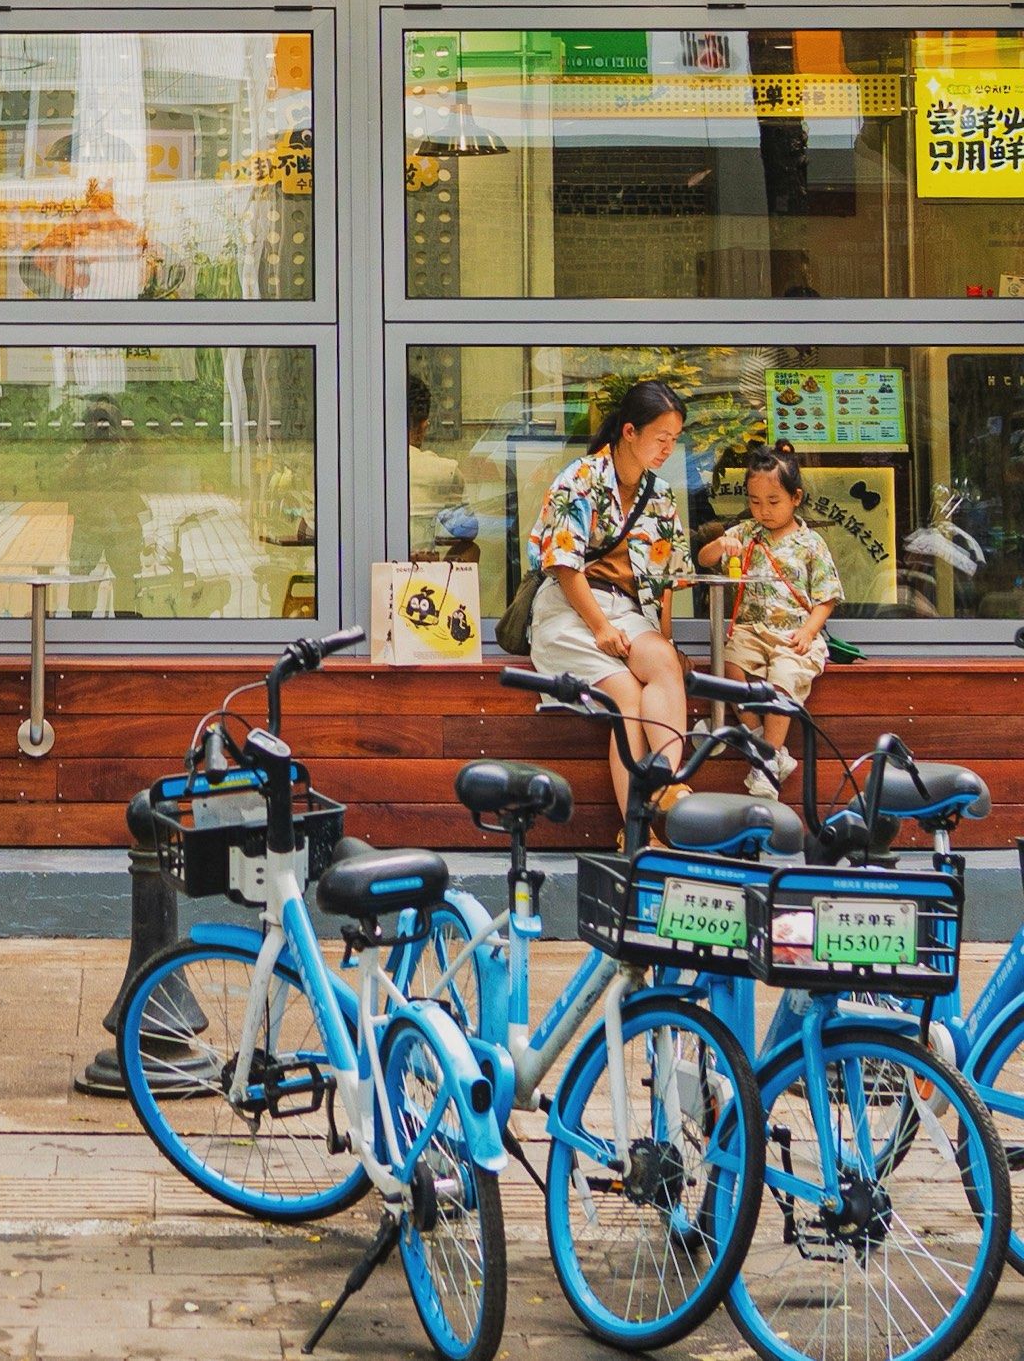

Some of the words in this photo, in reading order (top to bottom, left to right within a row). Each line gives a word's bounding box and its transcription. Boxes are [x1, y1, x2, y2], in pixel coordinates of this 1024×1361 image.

[929, 135, 1024, 172] 只用鲜
[669, 912, 742, 938] H29697
[825, 934, 906, 953] H53073
